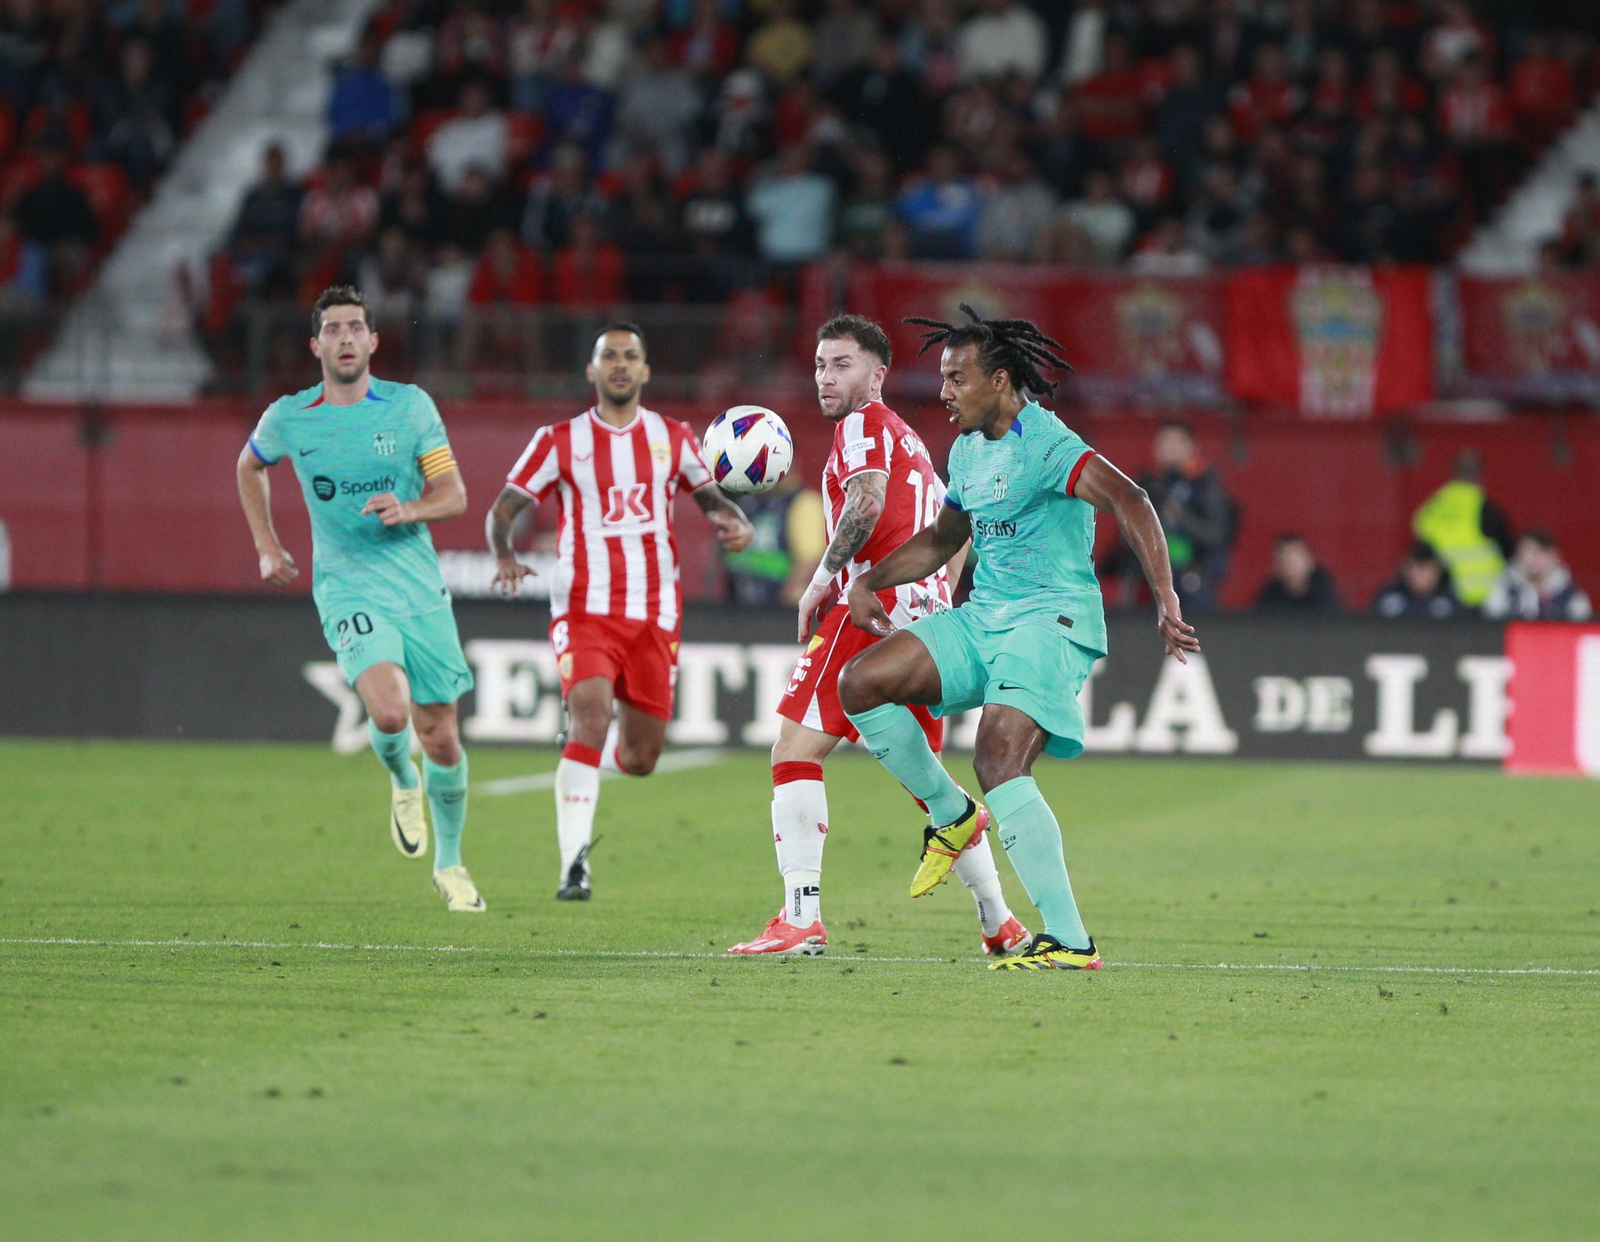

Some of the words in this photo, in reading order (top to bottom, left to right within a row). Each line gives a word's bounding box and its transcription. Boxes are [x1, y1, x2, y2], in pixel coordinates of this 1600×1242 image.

[340, 475, 397, 497] Spotify
[337, 612, 373, 648] 20
[1255, 675, 1353, 732] DE
